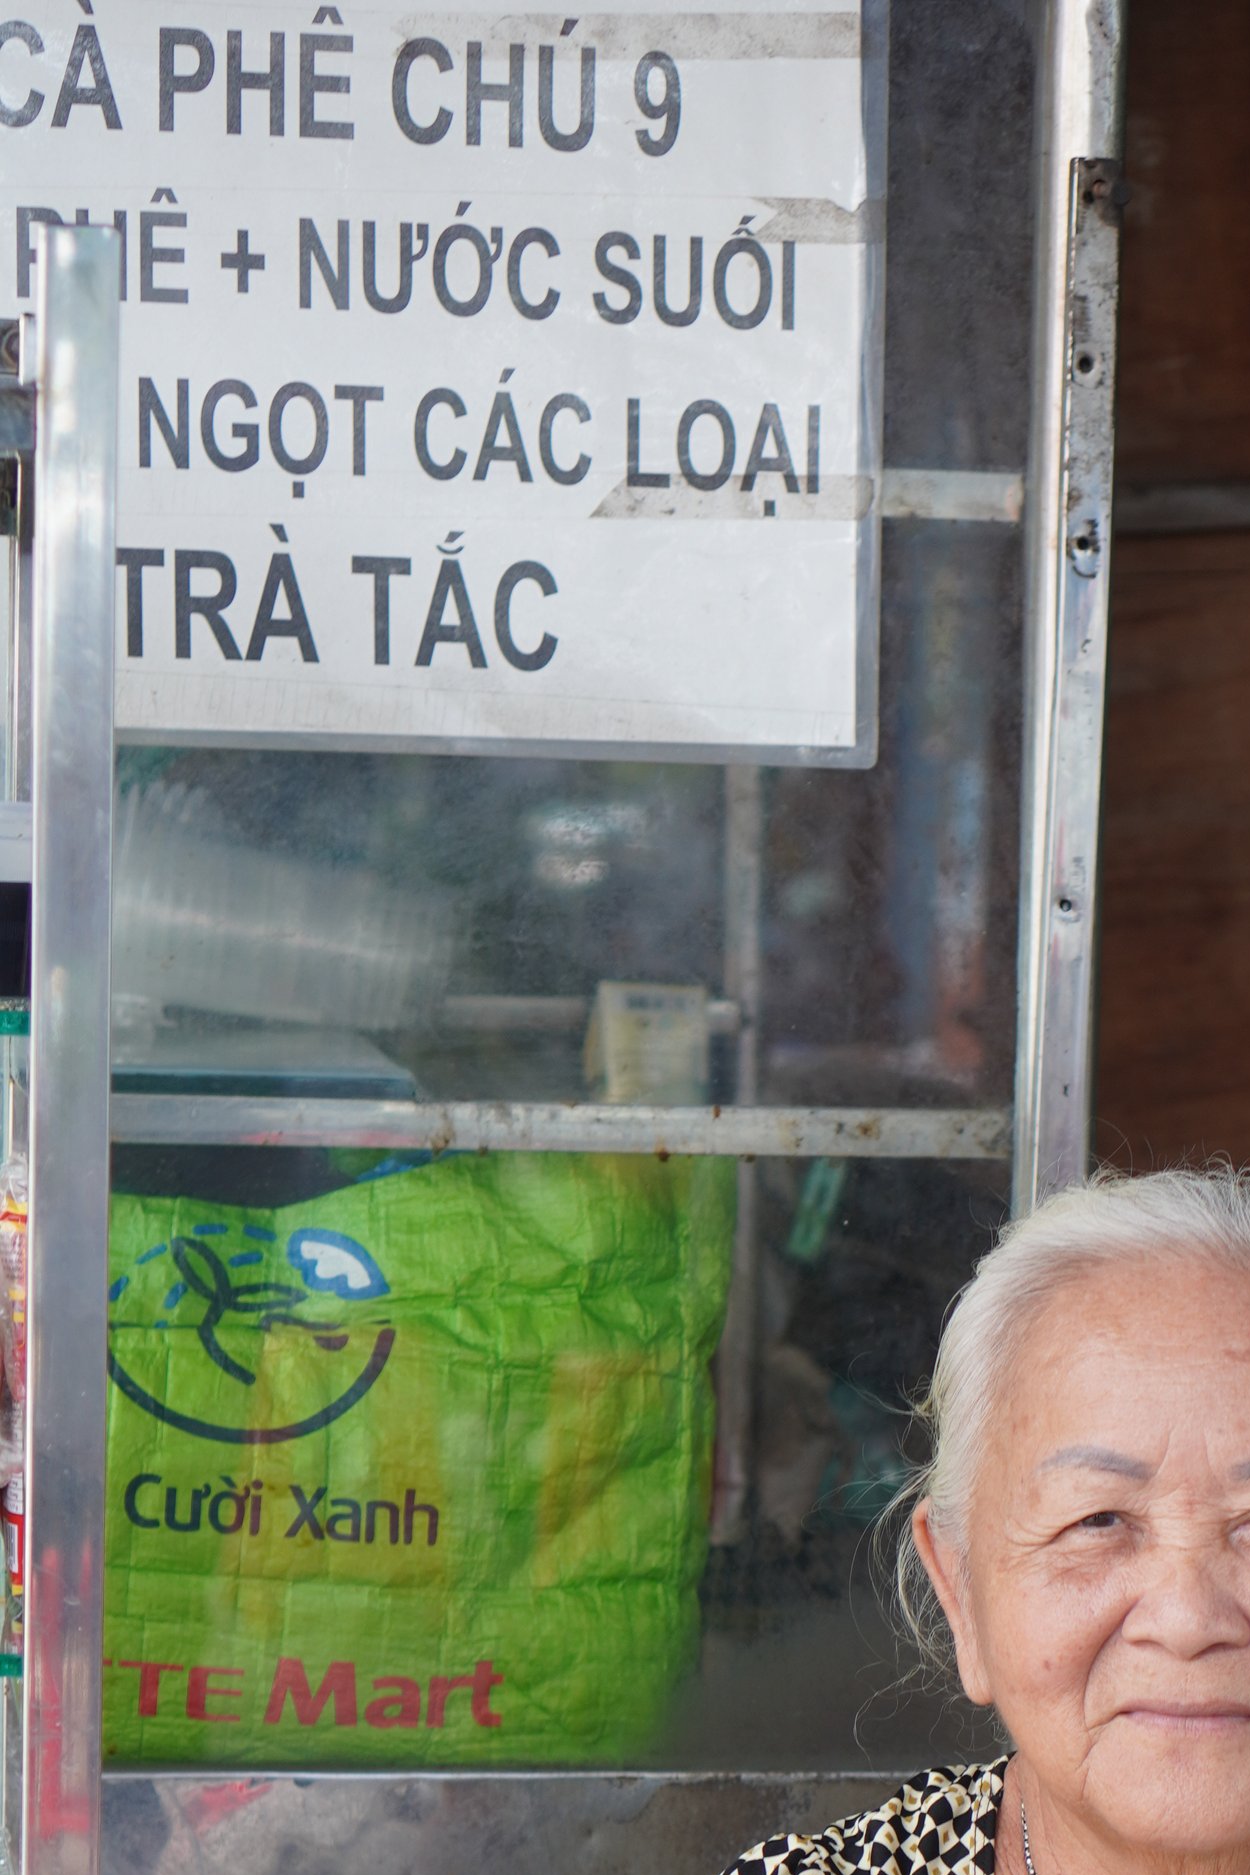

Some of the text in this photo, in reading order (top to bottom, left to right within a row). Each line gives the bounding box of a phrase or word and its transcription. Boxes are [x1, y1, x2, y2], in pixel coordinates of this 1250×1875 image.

[0, 0, 682, 157] CÀ PHÊ CHÚ 9
[220, 229, 266, 294] +
[299, 201, 561, 321] NƯỚC
[592, 215, 796, 331] SUỐI
[138, 368, 820, 517] NGỌT CÁC LOẠI
[115, 523, 559, 672] TRÀ TẮC
[125, 1473, 439, 1546] Cười Xanh
[264, 1656, 505, 1729] Mart
